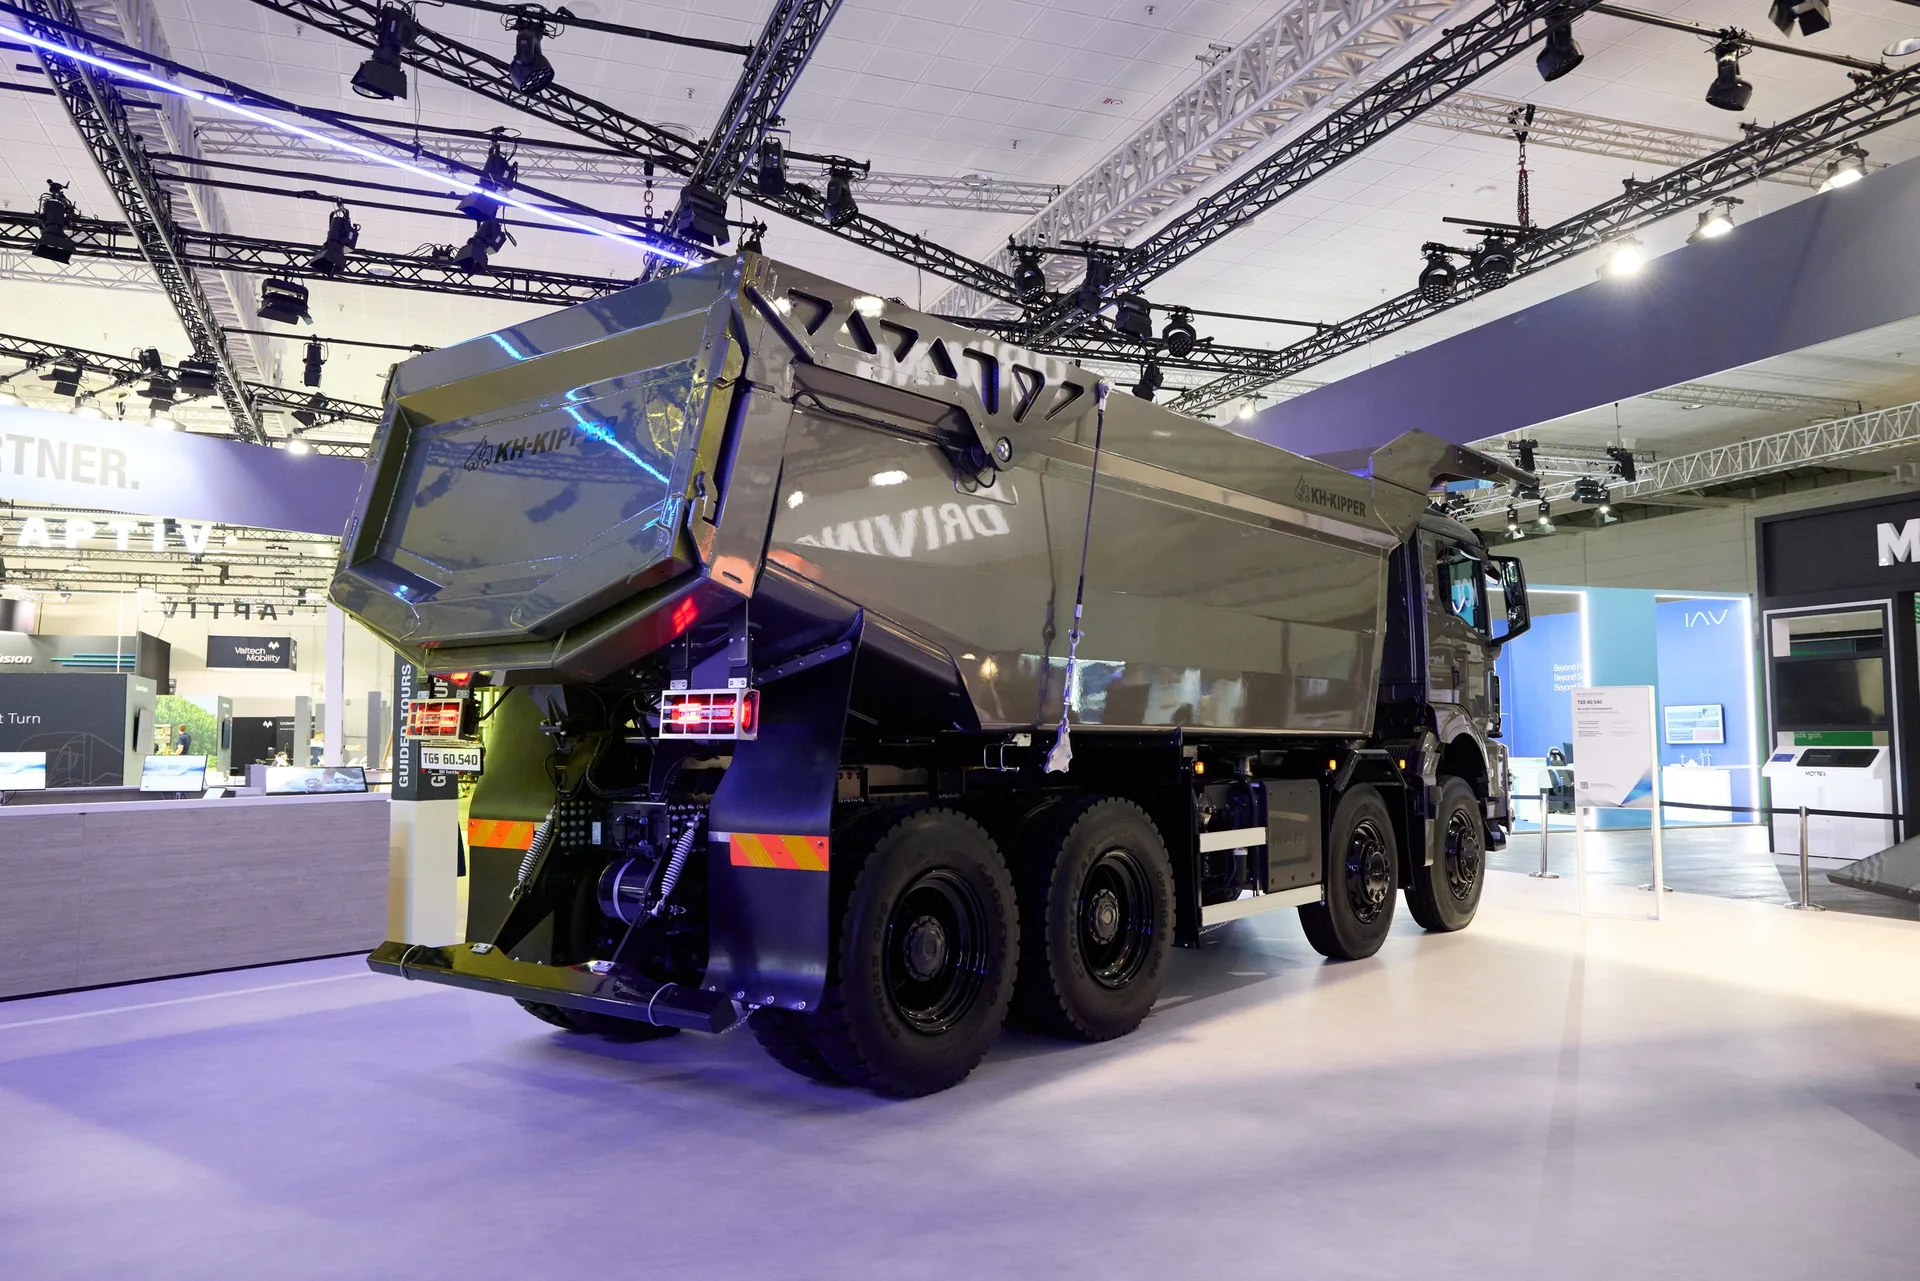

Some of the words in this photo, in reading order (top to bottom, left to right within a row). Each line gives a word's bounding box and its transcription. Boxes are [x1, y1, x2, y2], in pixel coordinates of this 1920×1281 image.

[0, 433, 140, 490] TNER.
[1311, 486, 1366, 518] KH-KIPPER
[16, 517, 213, 554] APTIV
[1685, 608, 1728, 628] IAV
[235, 646, 266, 655] Valtech
[246, 654, 280, 664] Mobility
[1553, 664, 1576, 673] Beyond
[1554, 673, 1577, 683] Beyond
[400, 663, 412, 720] TOURS
[7, 712, 41, 724] Turn
[398, 725, 410, 788] GUIDED
[423, 753, 439, 764] TGS
[443, 753, 478, 766] 60.540
